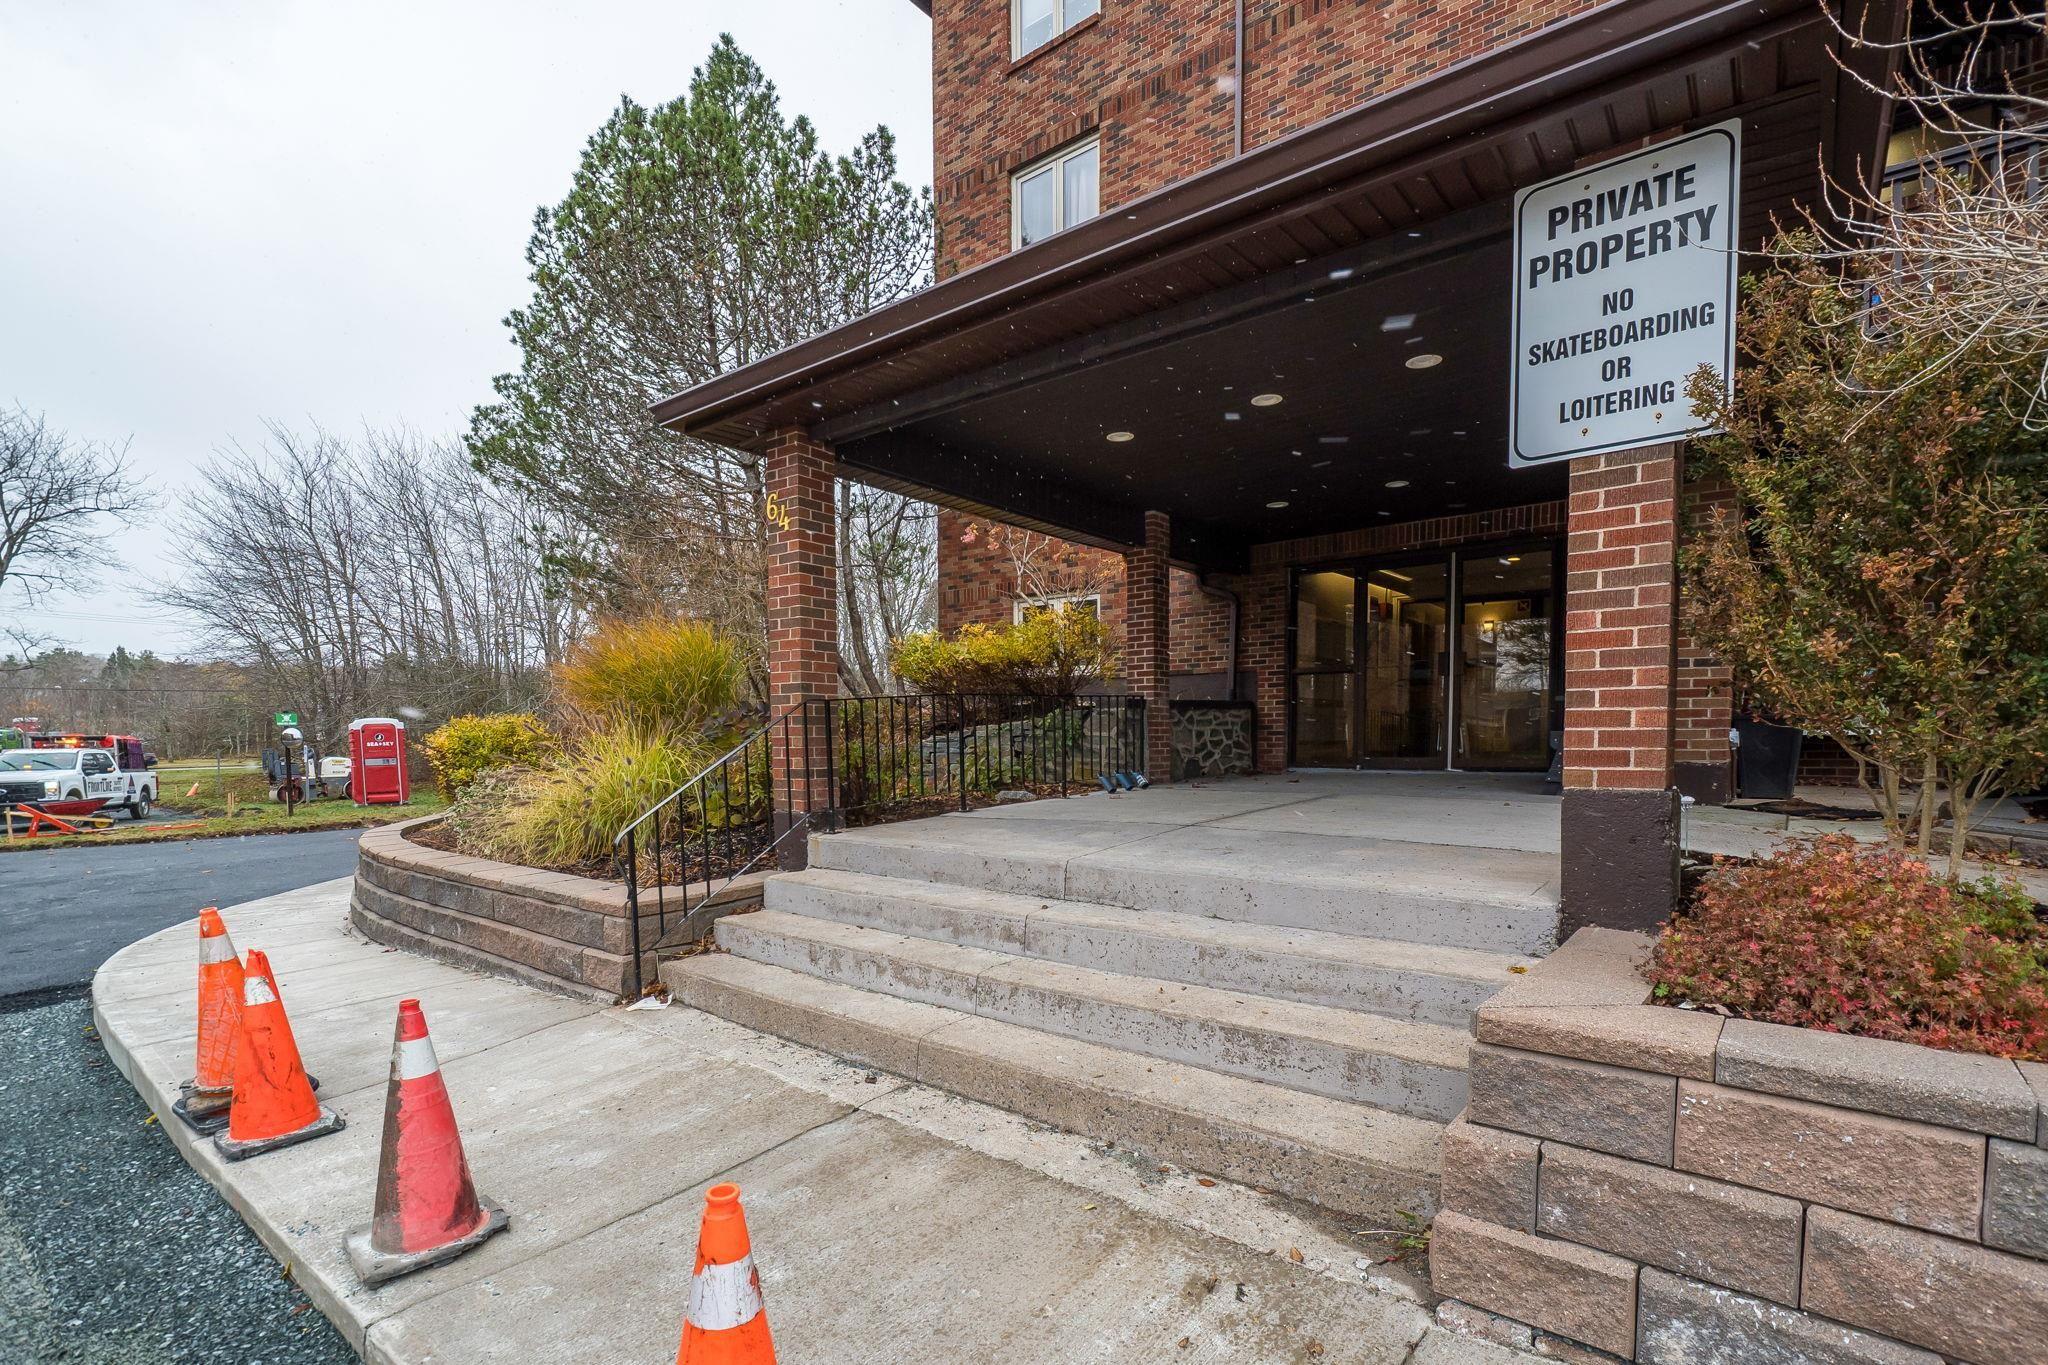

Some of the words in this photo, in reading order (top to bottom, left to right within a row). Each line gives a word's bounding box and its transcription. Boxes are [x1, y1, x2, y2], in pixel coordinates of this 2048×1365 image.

[1548, 163, 1696, 241] PRIVATE
[1529, 204, 1718, 289] PROPERTY
[1602, 287, 1634, 316] NO
[1528, 302, 1715, 366] SKATEBOARDING
[1601, 356, 1631, 382] OR
[1559, 380, 1675, 424] LOITERING
[766, 492, 790, 531] 64
